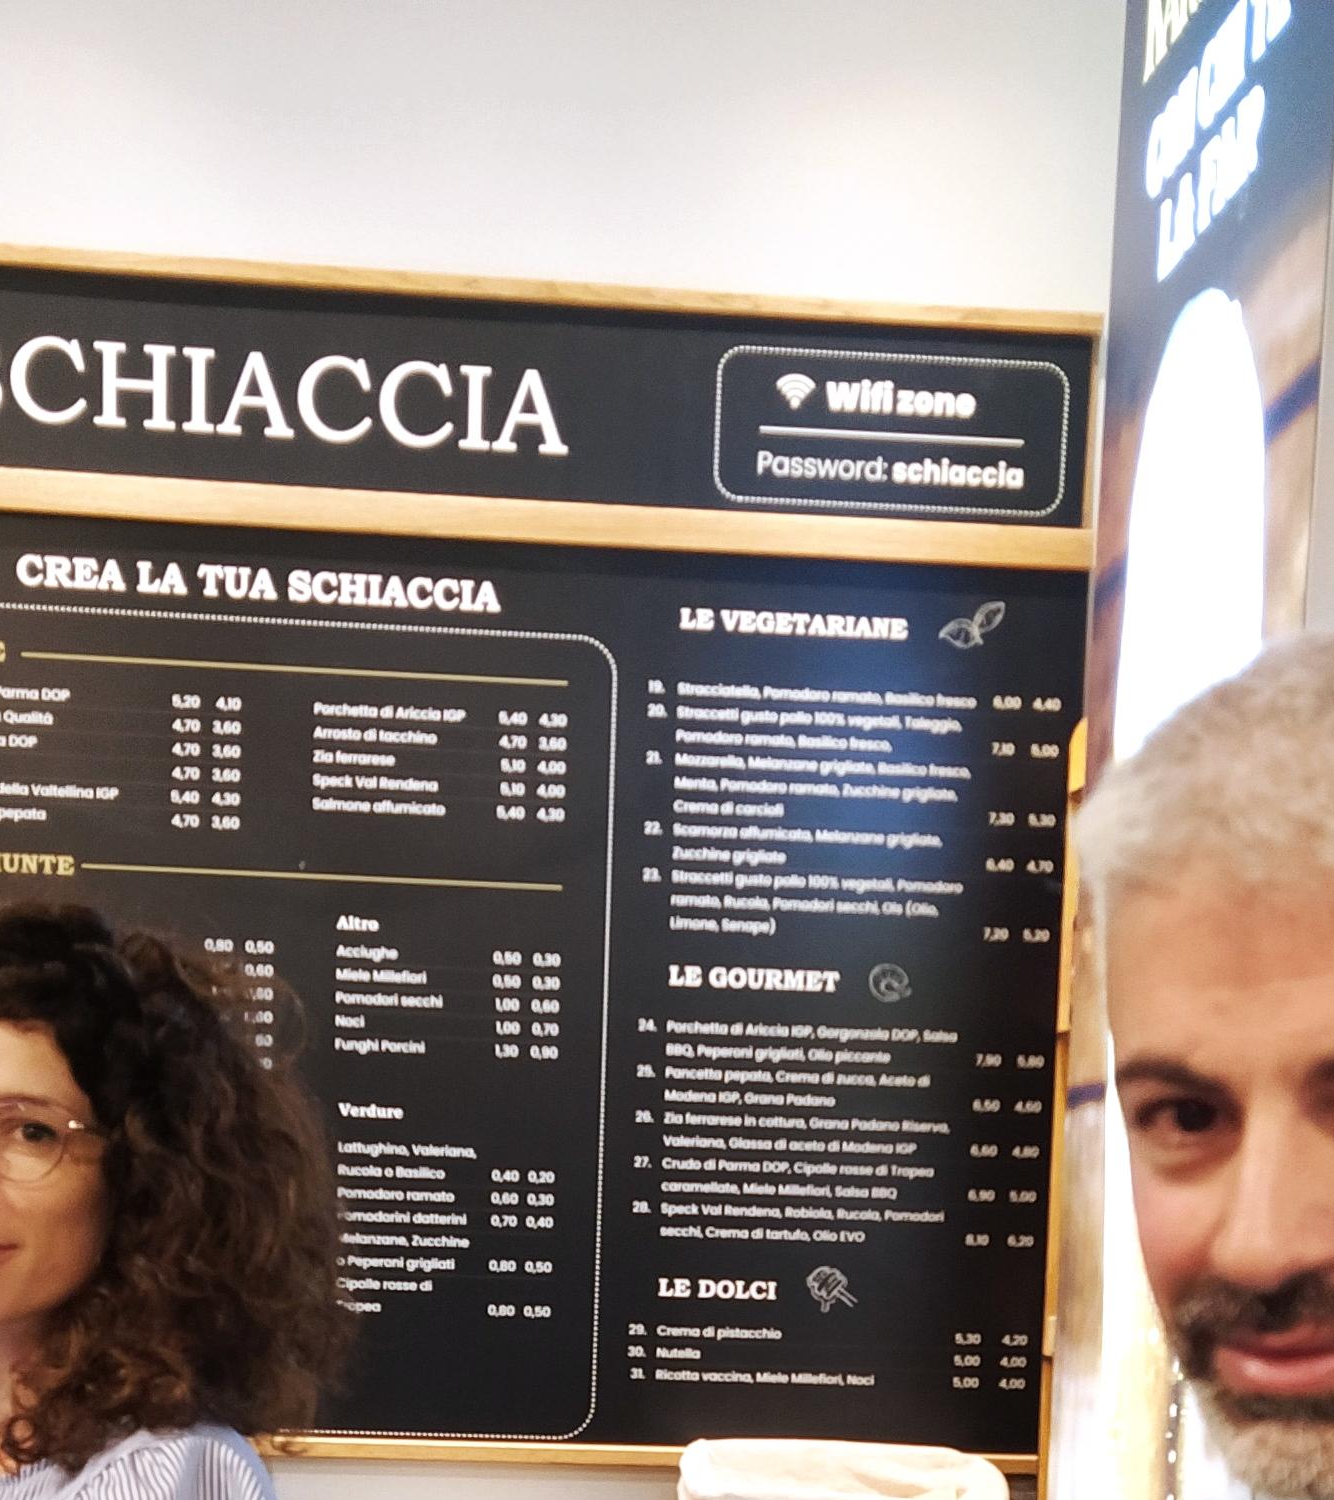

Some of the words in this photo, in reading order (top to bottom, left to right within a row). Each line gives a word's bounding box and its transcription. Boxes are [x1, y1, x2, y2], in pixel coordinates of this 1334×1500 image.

[825, 380, 895, 415] Wifi
[895, 388, 977, 420] zone
[756, 449, 889, 483] Password:
[891, 456, 1025, 490] schiaccia
[15, 552, 127, 593] CREA
[136, 559, 188, 597] LA
[196, 563, 279, 602] TUA
[287, 568, 502, 612] SCHIACCIA
[679, 606, 715, 632] LE
[720, 608, 909, 641] VEGETARIANE
[40, 686, 71, 702] DOP
[171, 693, 201, 709] 5,20
[215, 696, 242, 712] 4,10
[2, 709, 54, 726] Qualità
[171, 717, 202, 733] 4,70
[212, 719, 242, 735] 3,60
[7, 732, 38, 748] DOP
[171, 741, 201, 757] 4,70
[212, 743, 242, 759] 3,60
[171, 765, 201, 781] 4,70
[211, 767, 242, 783] 3,60
[30, 782, 95, 799] Valtellina
[95, 785, 120, 800] IGP
[211, 791, 241, 807] 4,30
[170, 813, 200, 828] 4,70
[211, 814, 241, 830] 3,60
[336, 914, 380, 932] Altro
[668, 964, 703, 988] LE
[708, 965, 841, 993] GOURMET
[338, 1101, 404, 1120] Verdure
[657, 1277, 692, 1298] LE
[697, 1277, 778, 1300] DOLCI
